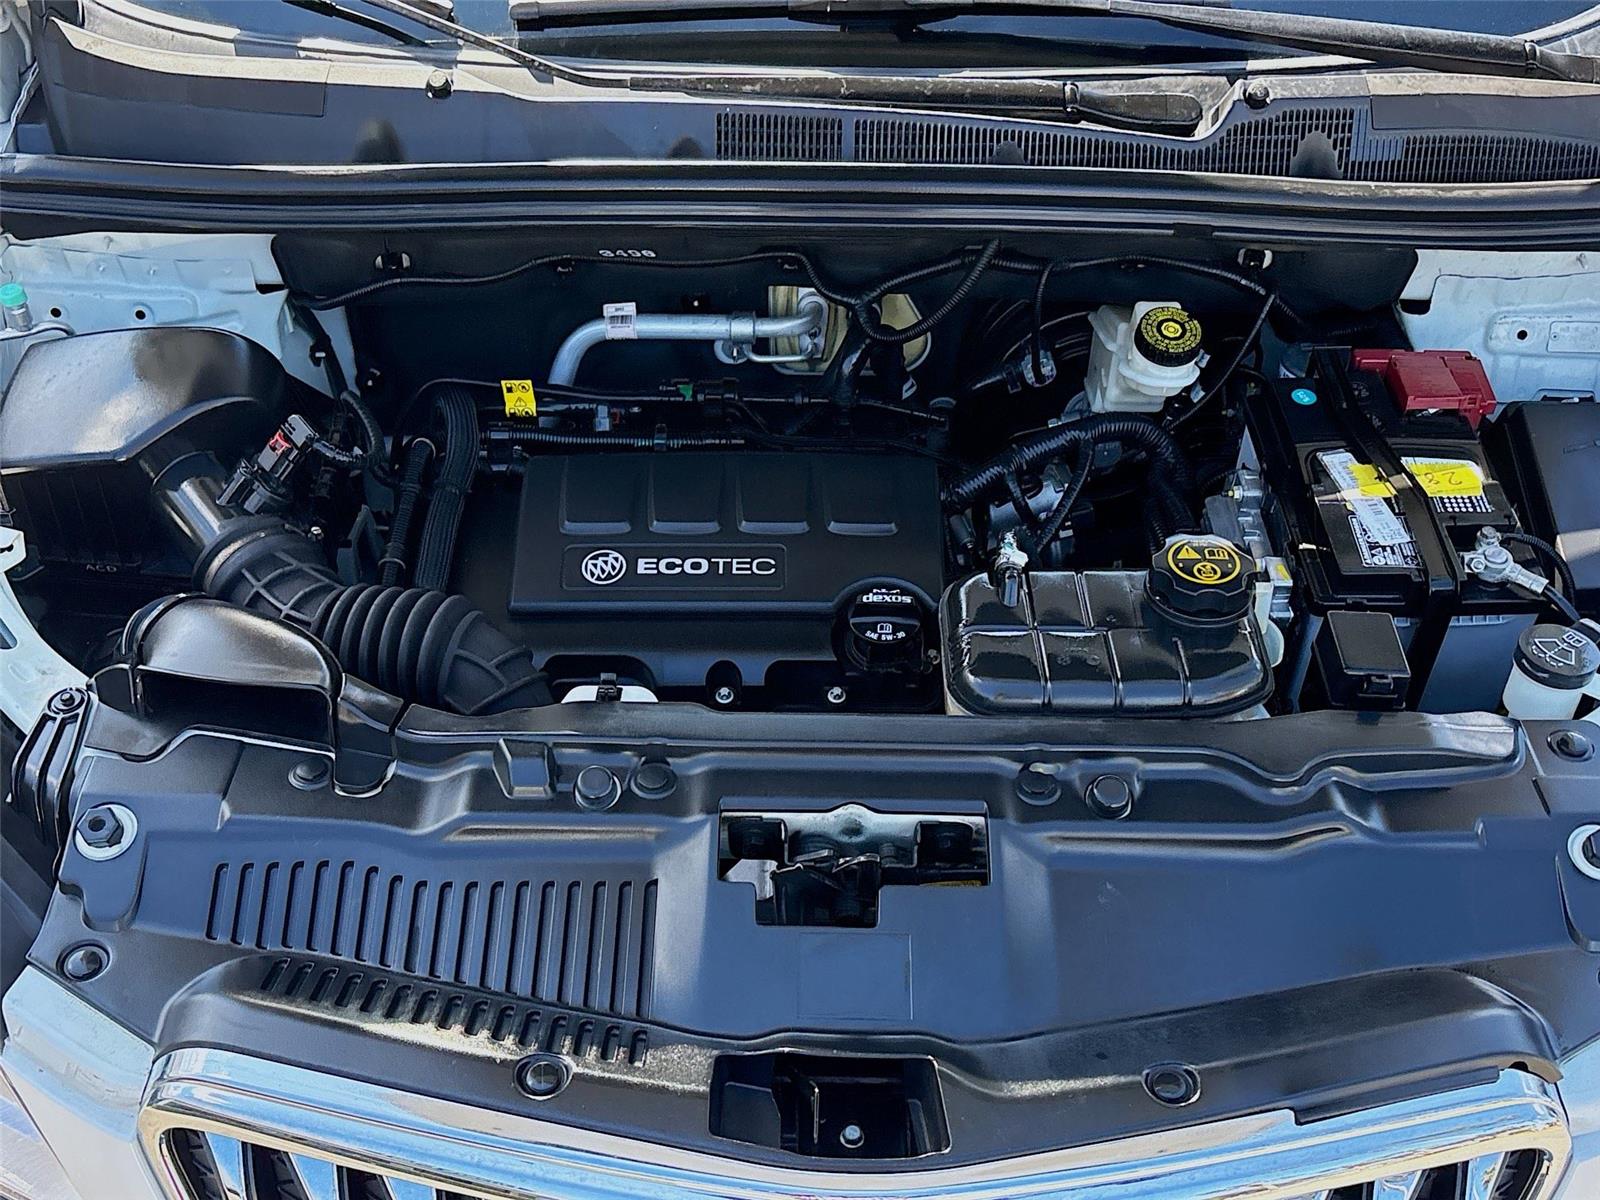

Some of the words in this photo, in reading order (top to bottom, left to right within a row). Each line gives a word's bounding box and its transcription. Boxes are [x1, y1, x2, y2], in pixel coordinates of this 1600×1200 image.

[636, 557, 777, 575] ECOTEC
[862, 592, 914, 604] dexos
[864, 630, 880, 641] SAE
[881, 631, 906, 641] 5W-30
